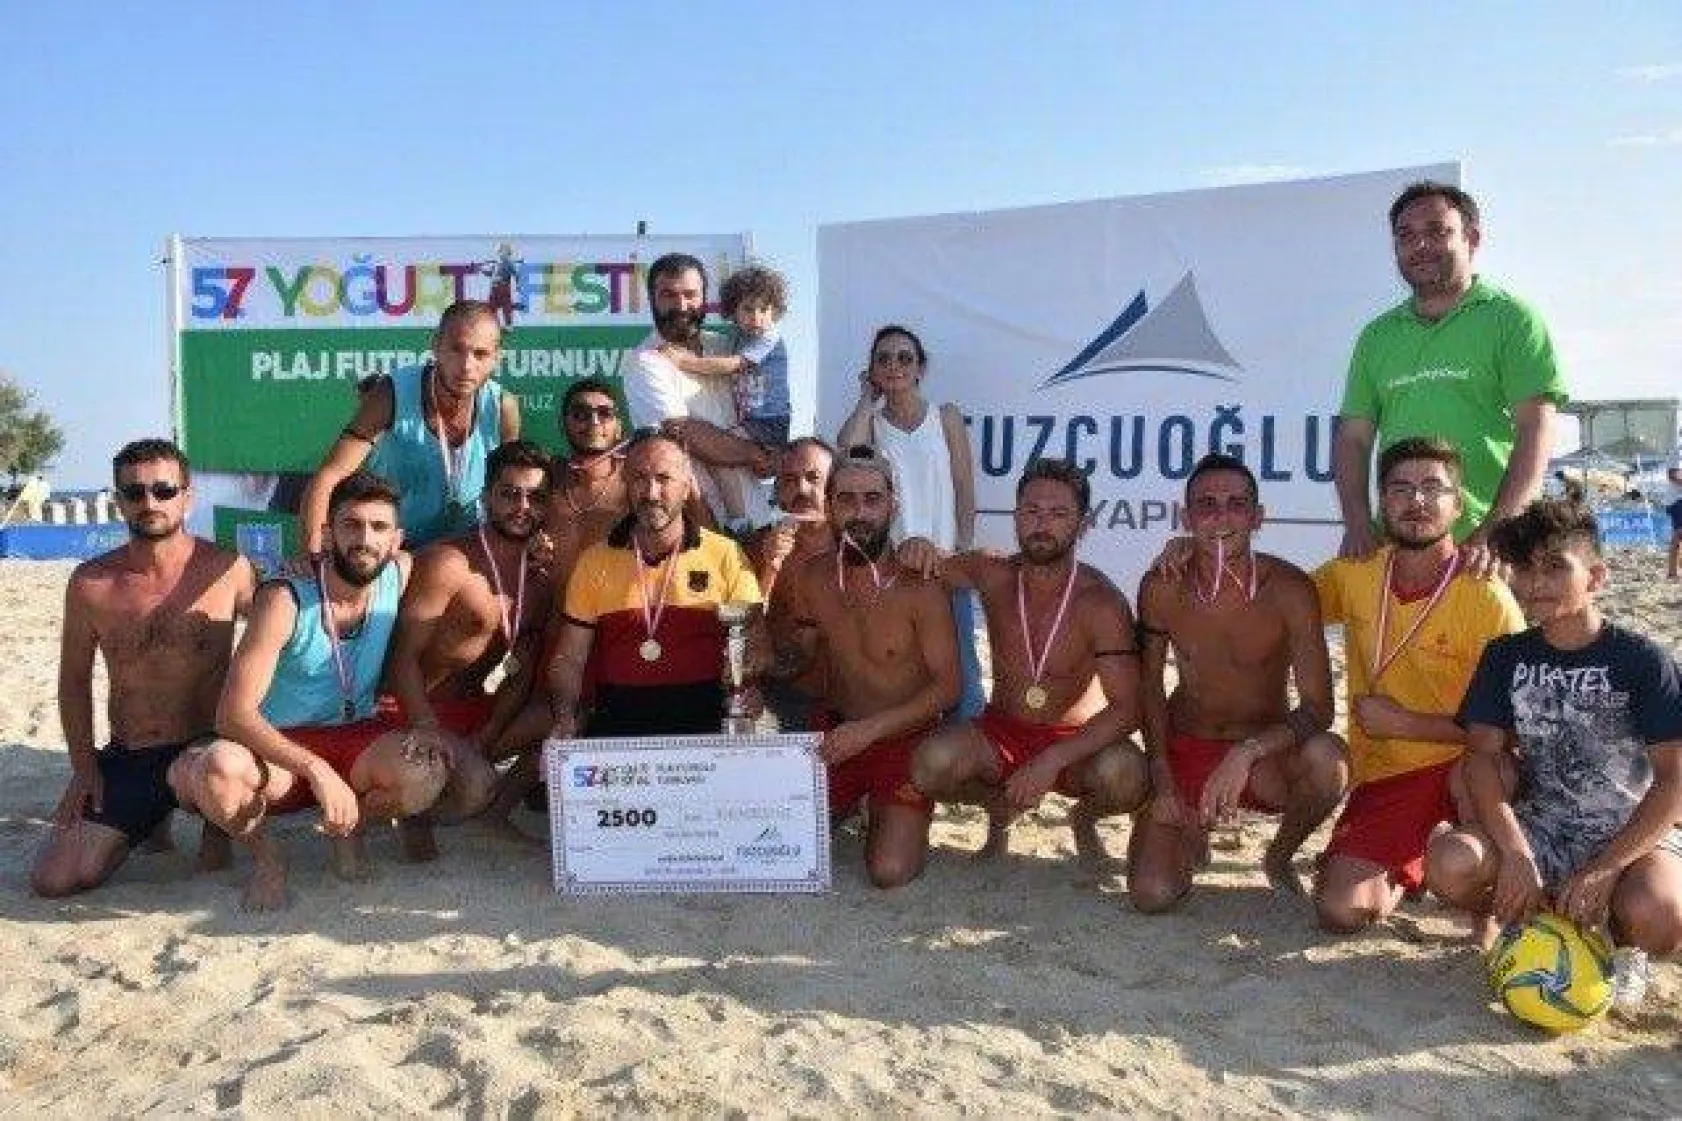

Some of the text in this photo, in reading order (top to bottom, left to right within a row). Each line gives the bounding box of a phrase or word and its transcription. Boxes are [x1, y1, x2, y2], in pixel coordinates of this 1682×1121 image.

[191, 265, 256, 319] 57
[265, 254, 483, 317] YOĞURT
[252, 348, 632, 380] PLAJ FUTB TURNUV
[964, 404, 1342, 482] UZCUOĞLU
[1090, 499, 1178, 531] YAPI
[573, 765, 598, 788] 57
[597, 808, 657, 828] 2500
